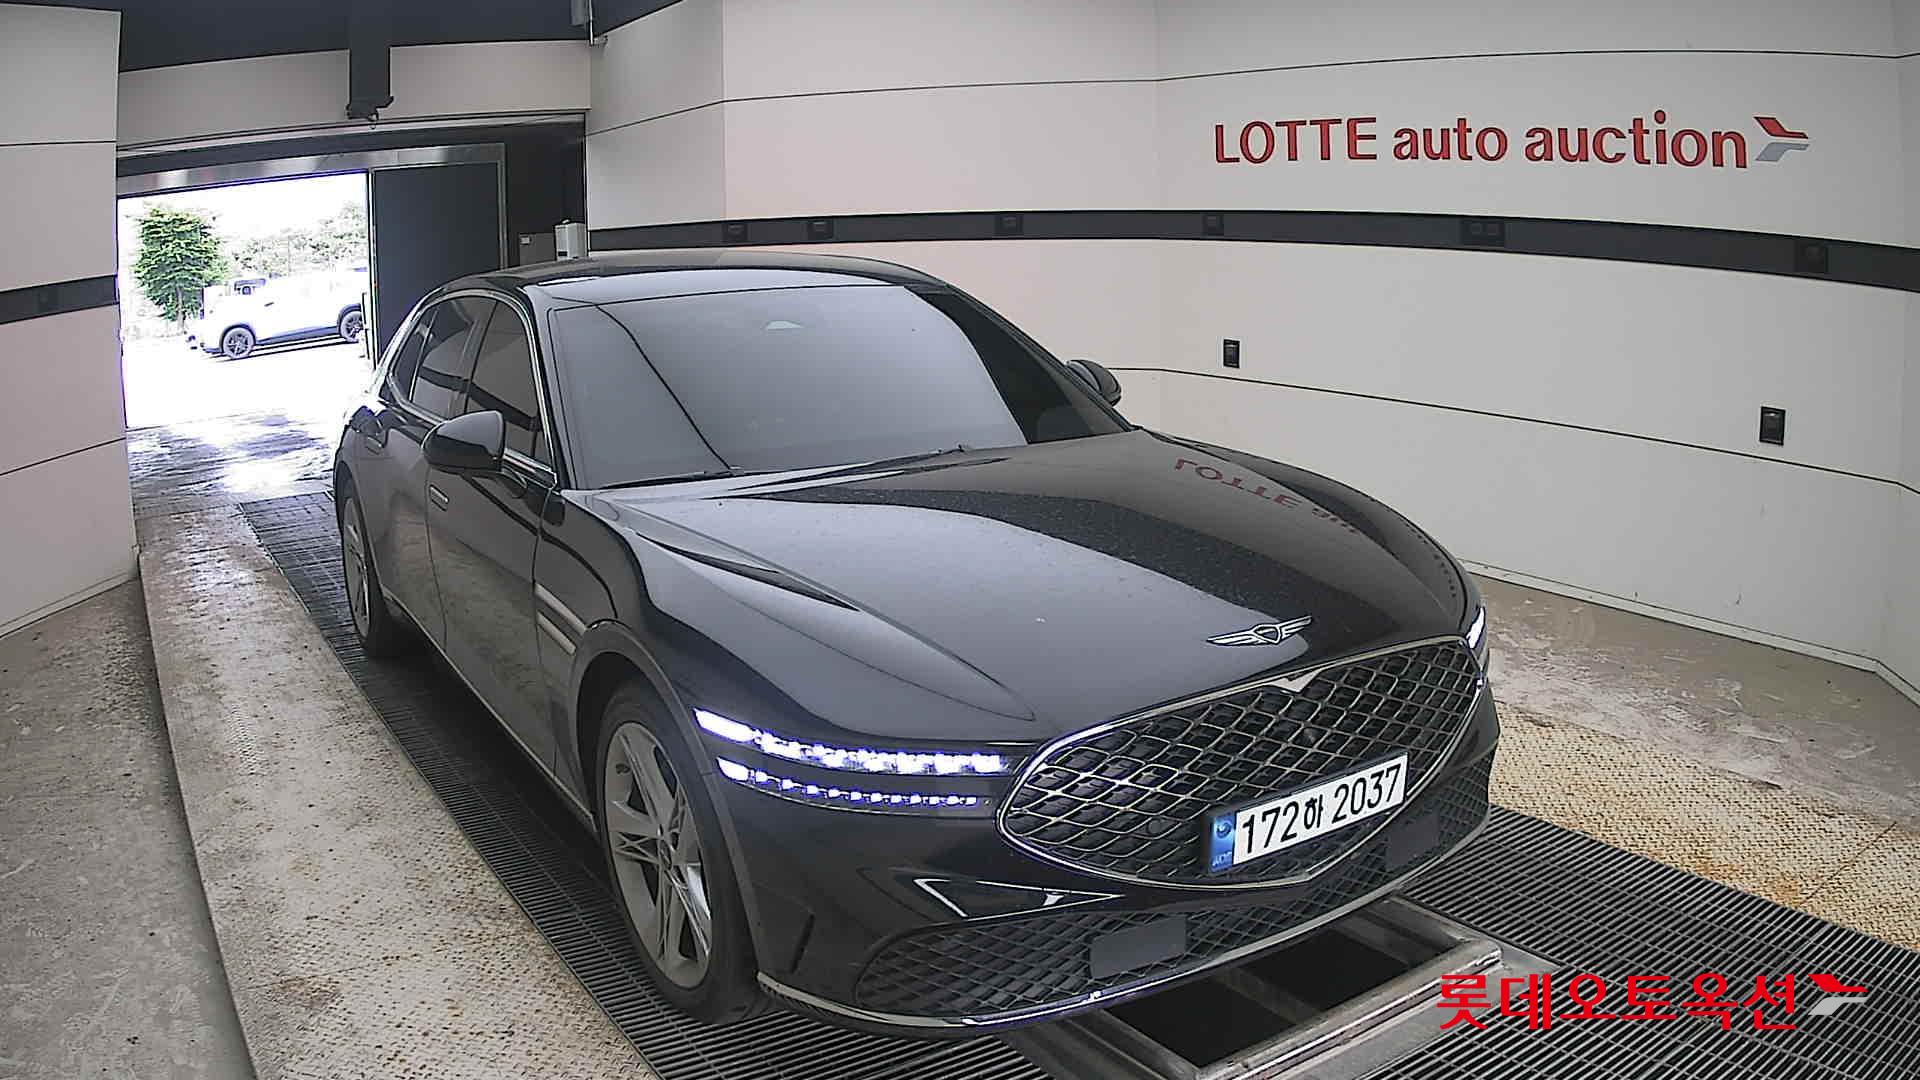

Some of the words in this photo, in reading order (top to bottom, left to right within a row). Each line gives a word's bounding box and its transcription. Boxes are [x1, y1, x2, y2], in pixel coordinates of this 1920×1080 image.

[1215, 117, 1377, 164] LOTTE
[1393, 118, 1508, 162] auto
[1525, 110, 1748, 169] auction
[1242, 794, 1324, 854] 172하
[1332, 765, 1401, 823] 2037
